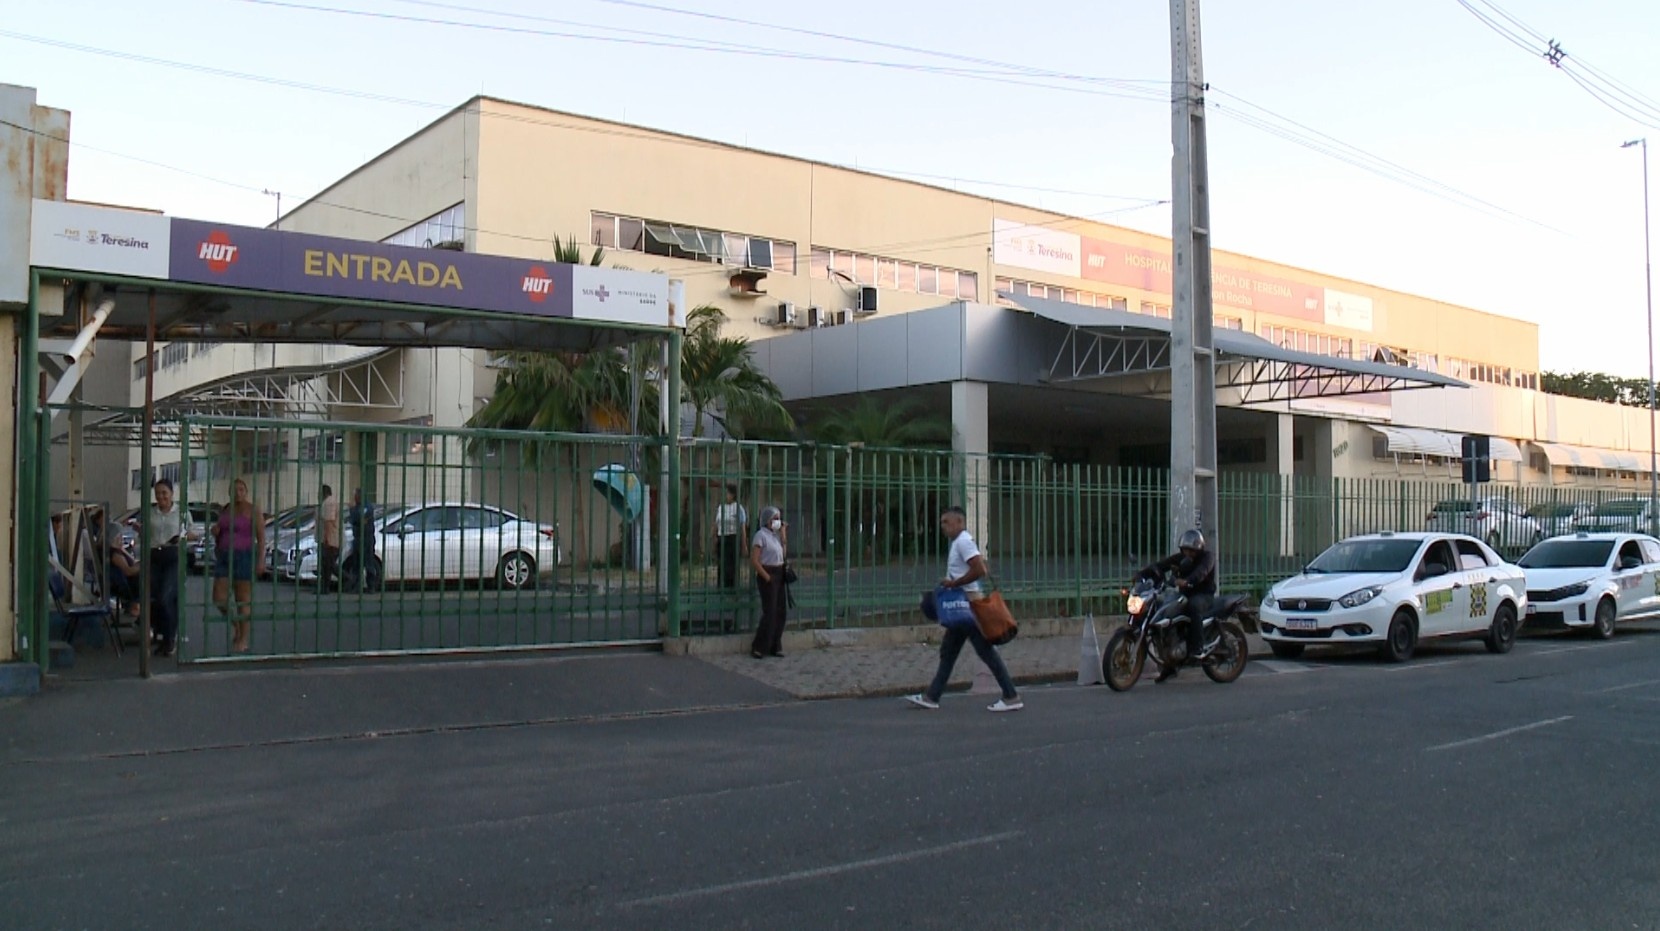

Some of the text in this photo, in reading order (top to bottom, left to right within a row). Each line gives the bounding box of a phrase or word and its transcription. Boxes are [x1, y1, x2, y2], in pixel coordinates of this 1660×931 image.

[101, 233, 149, 250] Teresina
[199, 242, 238, 262] HUT
[1038, 243, 1073, 260] Teresina
[1087, 253, 1106, 268] HUT
[304, 249, 463, 290] ENTRADA
[1124, 252, 1172, 273] HOSPITAL
[1239, 277, 1250, 290] DE
[1253, 279, 1292, 298] TERESINA
[522, 275, 553, 294] HUT
[1227, 292, 1252, 305] Rocha
